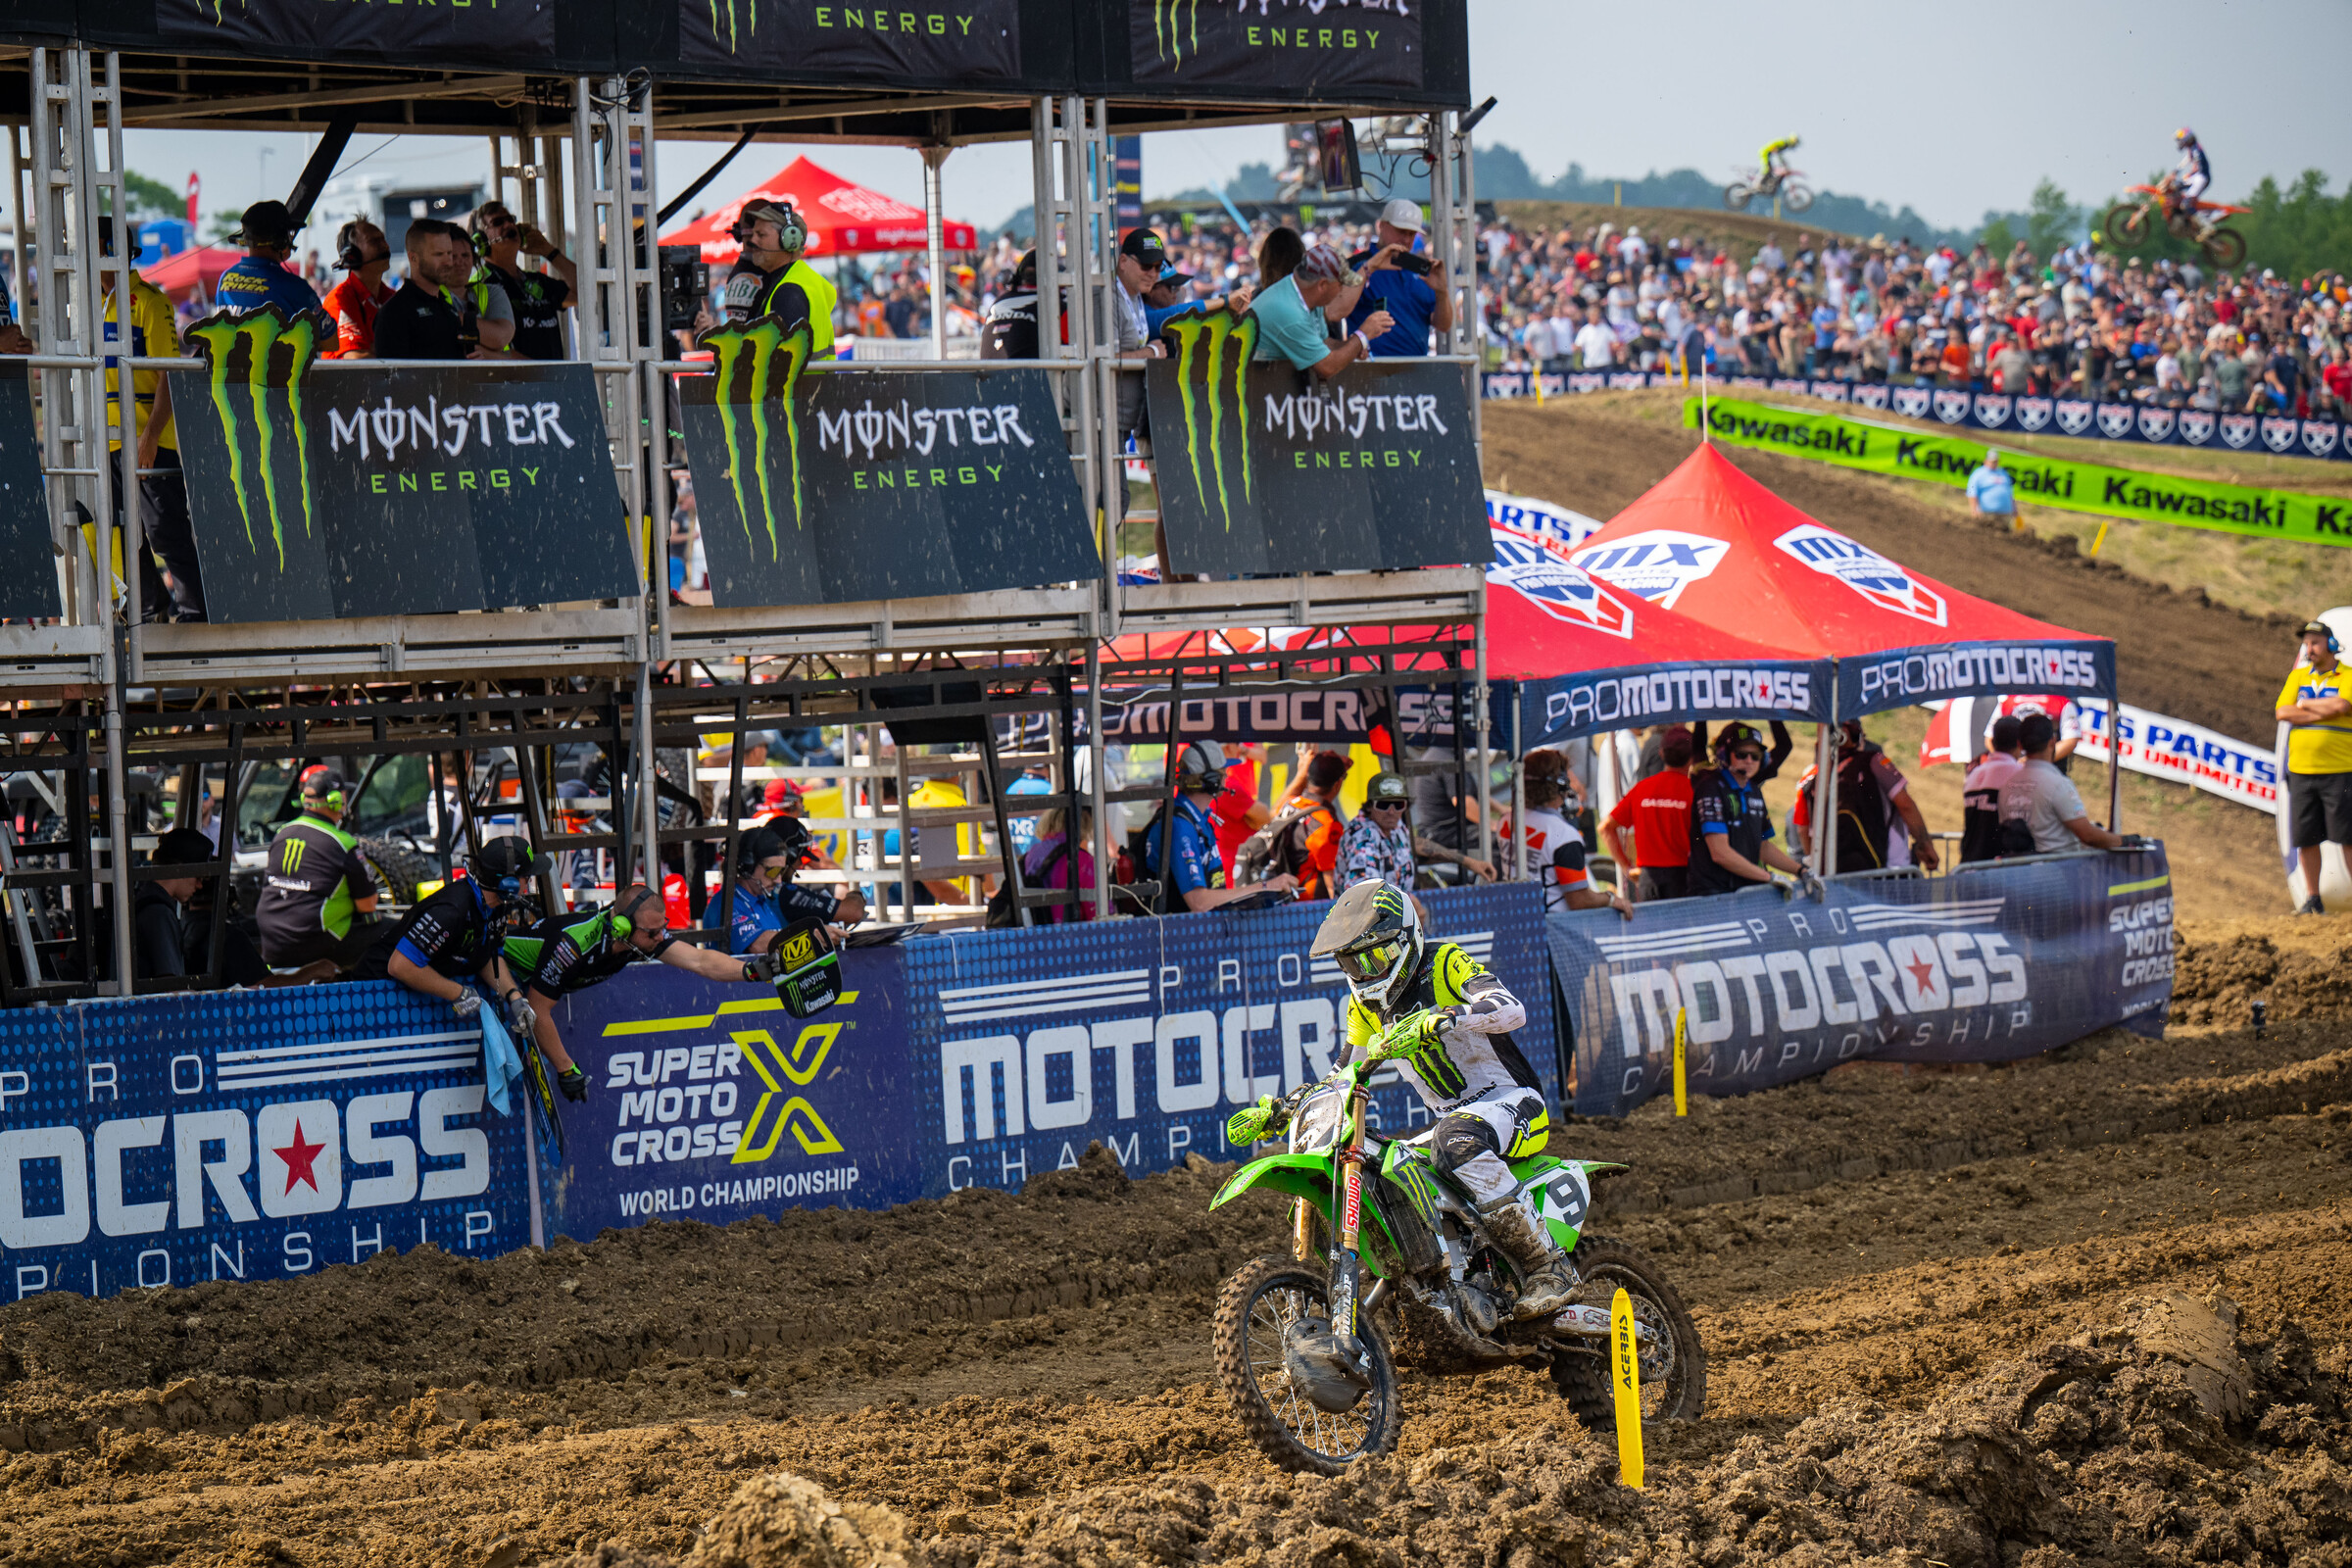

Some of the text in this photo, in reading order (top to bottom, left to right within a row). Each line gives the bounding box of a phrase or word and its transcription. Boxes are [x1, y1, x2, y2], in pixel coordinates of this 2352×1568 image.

[816, 7, 973, 35] ENERGY
[1248, 26, 1379, 49] ENERGY
[220, 282, 270, 293] RIVER
[223, 272, 269, 284] ROCK
[327, 395, 575, 462] MONSTER
[816, 399, 1035, 460] MONSTER
[1264, 385, 1448, 441] MONSTER
[370, 467, 540, 494] ENERGY
[854, 465, 1003, 489] ENERGY
[1295, 450, 1422, 468] ENERGY
[1696, 403, 1868, 458] Kawasaki
[1896, 438, 2074, 498] Kawsaki
[2103, 476, 2286, 527] Kawasaki
[2145, 749, 2277, 801] UNLIMITED
[2147, 725, 2277, 784] PARTS
[1641, 797, 1688, 810] GASGAS
[1746, 907, 1848, 943] PRO
[1159, 954, 1301, 1000] PRO
[1609, 931, 2028, 1058] MOTOCROSS
[805, 989, 835, 1013] Kawasaki
[0, 1054, 203, 1111] PRO
[606, 1043, 742, 1088] SUPER
[618, 1081, 738, 1126] MOTO
[612, 1120, 742, 1166] CROSS
[619, 1166, 859, 1217] WORLD CHAMPIONSHIP
[1347, 1175, 1362, 1231] SHOWA
[1546, 1172, 1588, 1227] 9
[1343, 1274, 1352, 1336] DUNLOP
